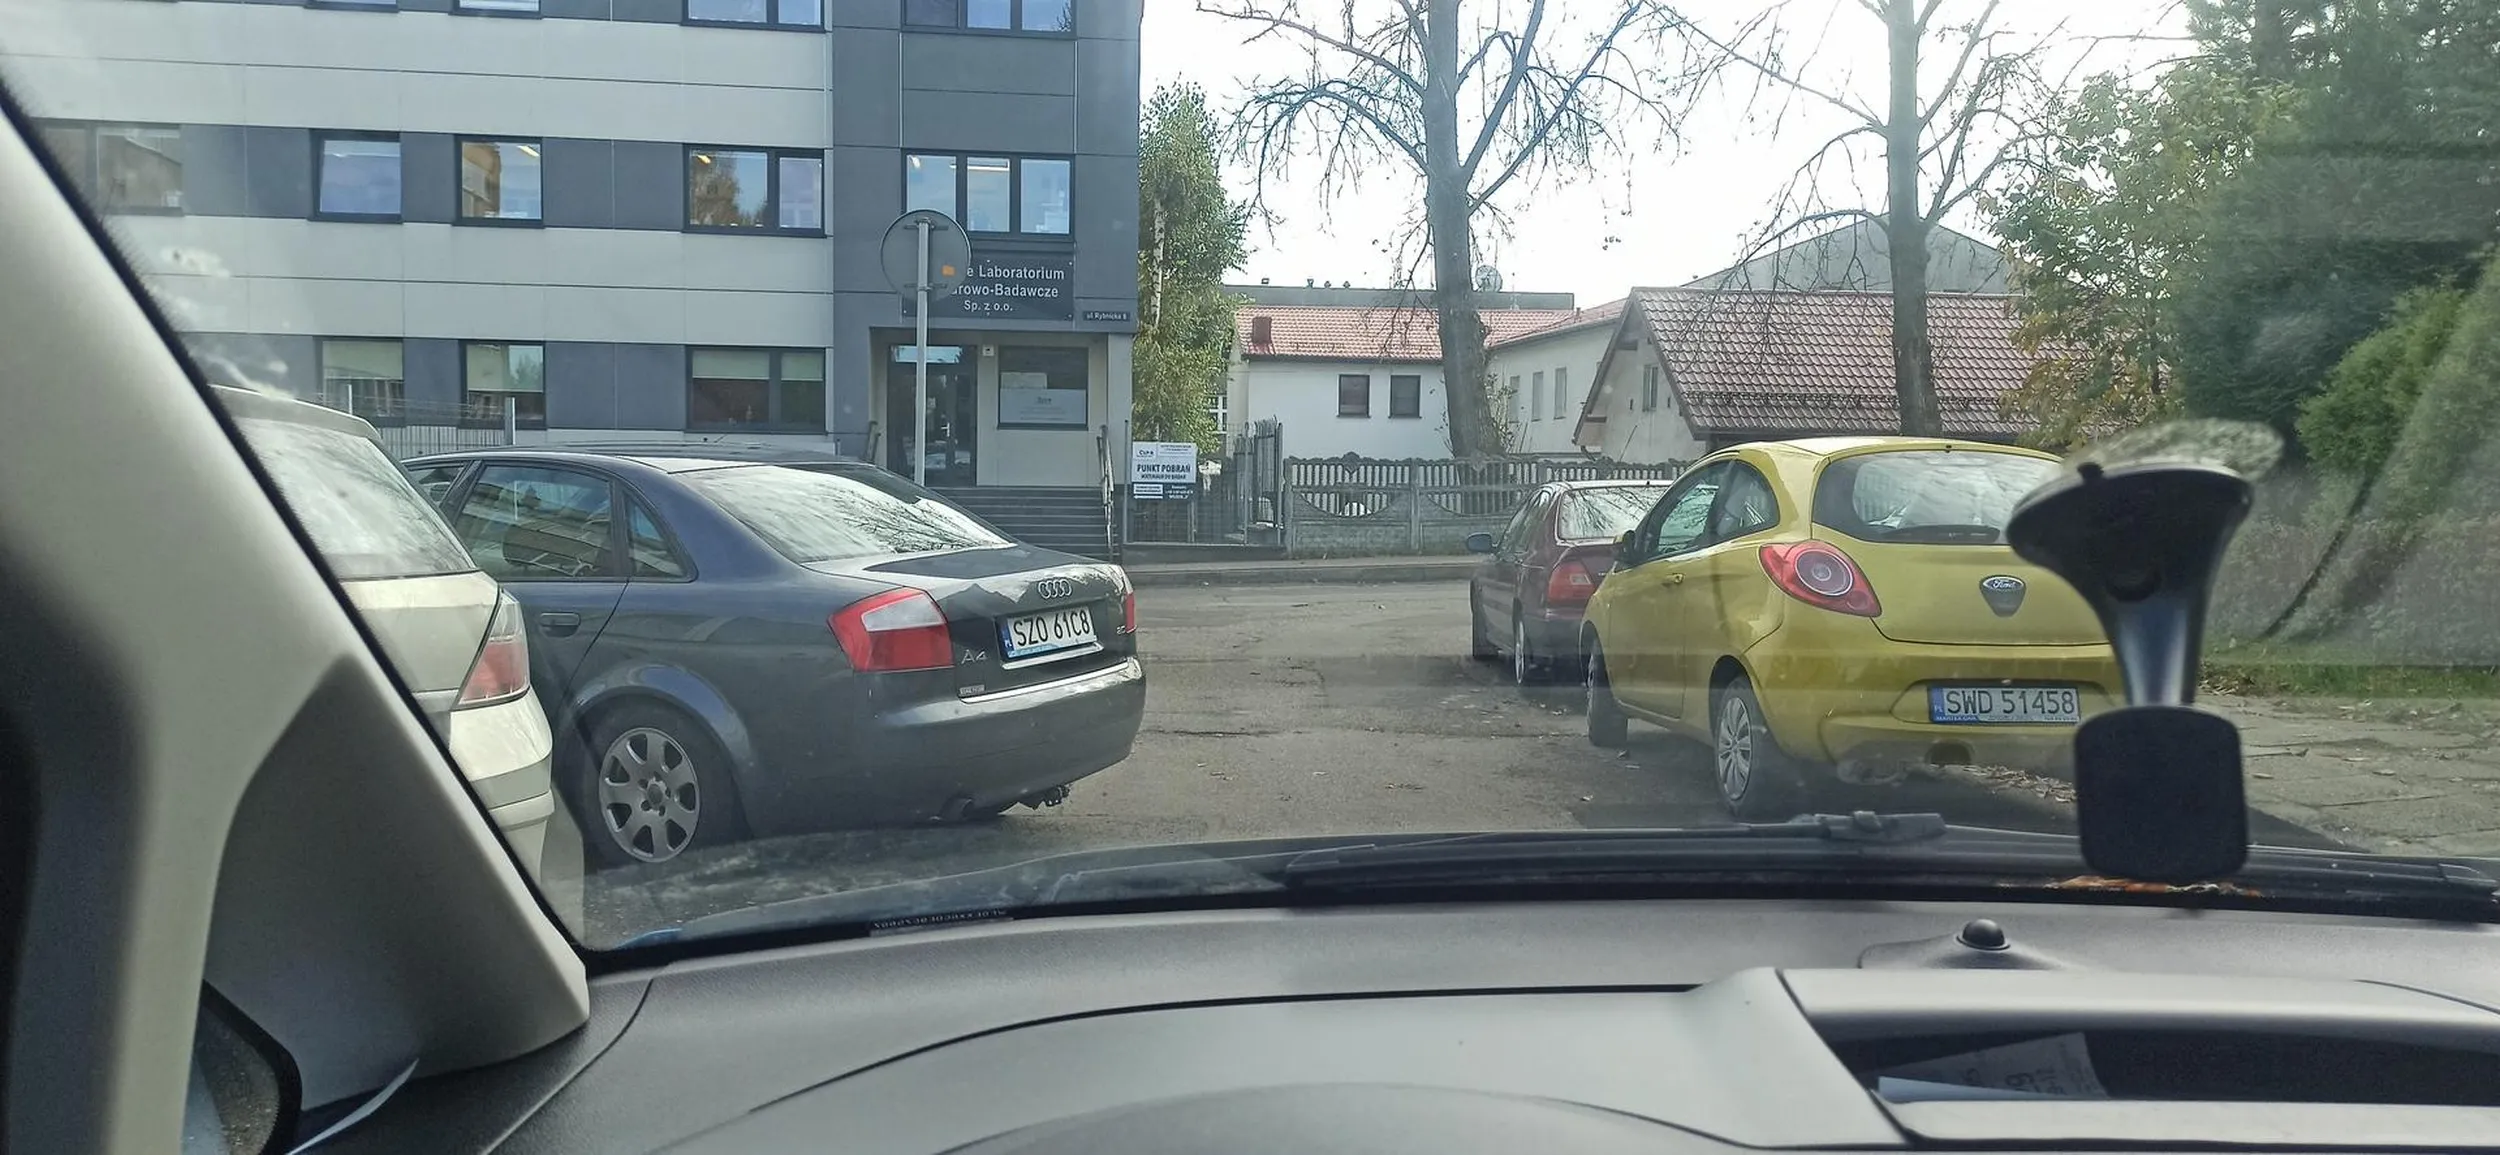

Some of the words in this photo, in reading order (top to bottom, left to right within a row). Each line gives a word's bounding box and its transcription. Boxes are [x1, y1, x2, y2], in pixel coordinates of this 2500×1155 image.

[979, 265, 1065, 280] Laboratorium
[964, 300, 982, 312] Sp.
[984, 302, 991, 311] z
[993, 302, 1013, 311] o.o.
[1137, 464, 1160, 472] PUNKT
[1993, 580, 2015, 588] Ford
[1013, 616, 1049, 647] SZO
[1054, 610, 1091, 640] 61C8
[961, 650, 987, 664] A4
[1946, 690, 1993, 714] SWD
[2001, 690, 2075, 714] 51458
